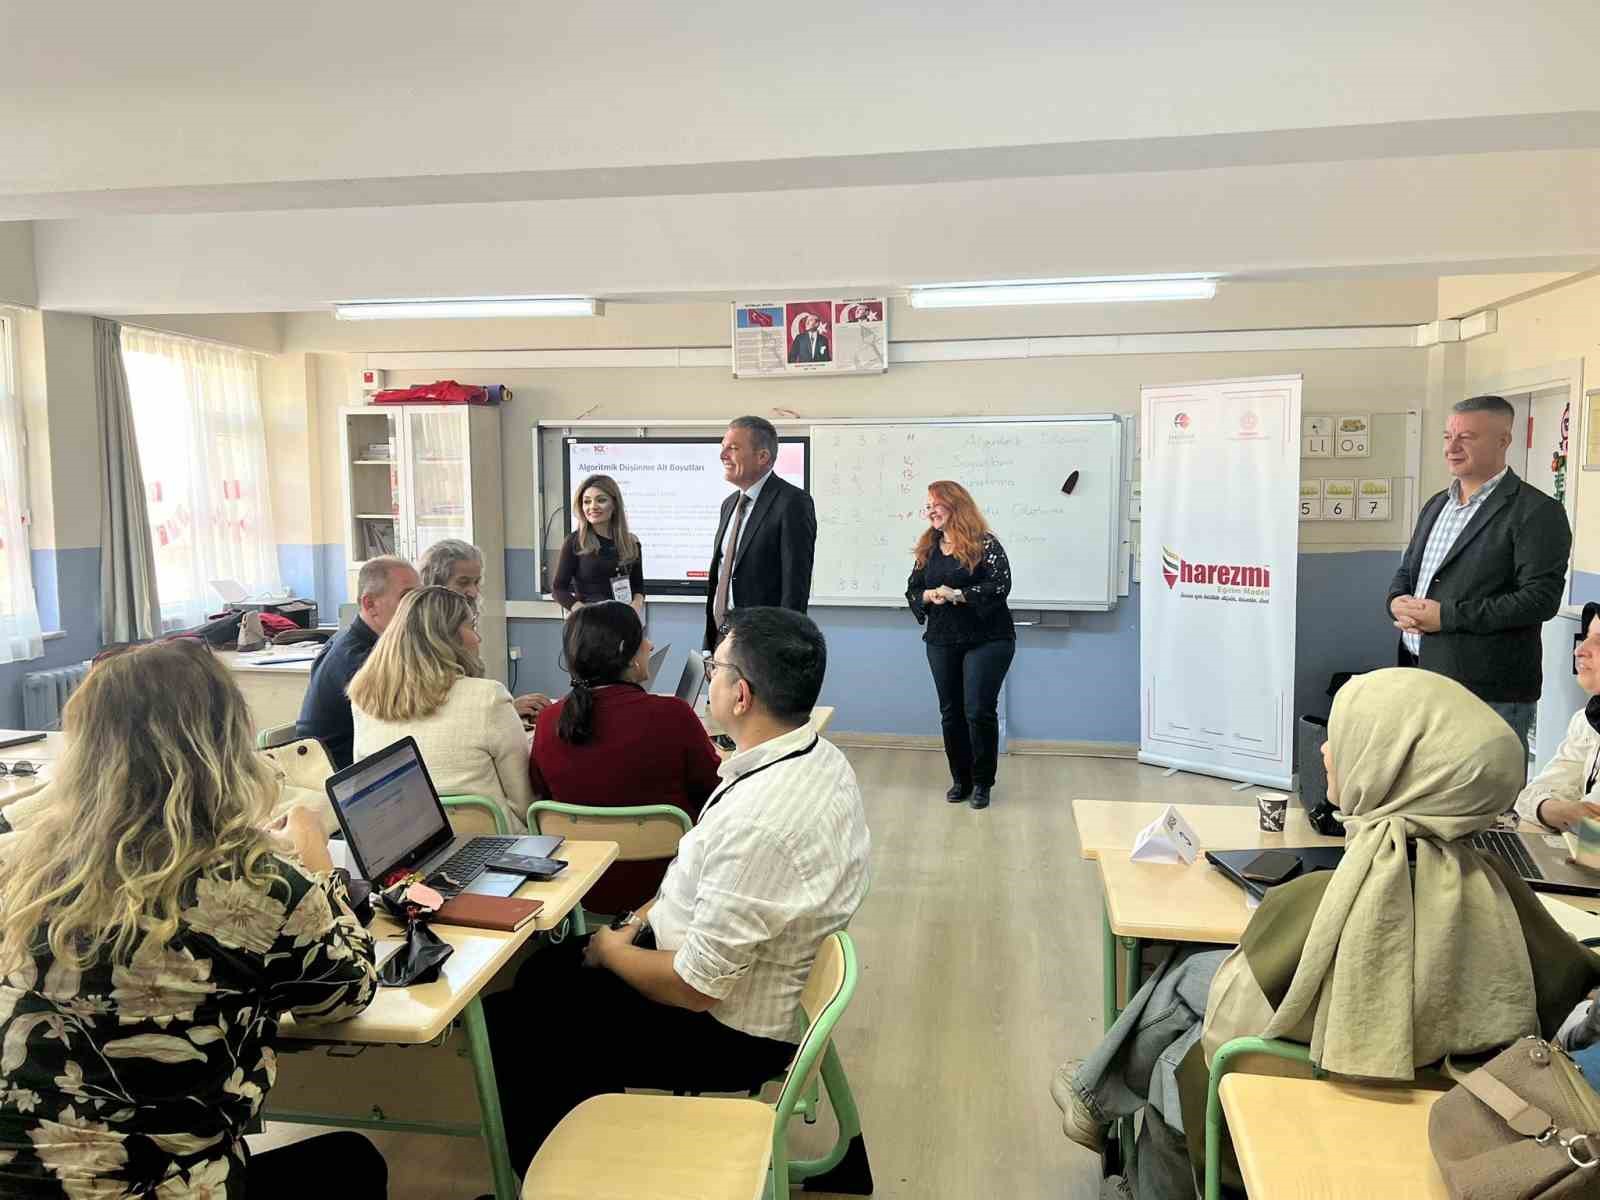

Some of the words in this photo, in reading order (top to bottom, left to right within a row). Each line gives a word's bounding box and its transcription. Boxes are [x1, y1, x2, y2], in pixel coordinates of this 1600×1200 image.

[578, 463, 618, 473] Algoritmik
[1301, 502, 1311, 515] 5
[1333, 502, 1343, 515] 6
[1368, 501, 1378, 514] 7
